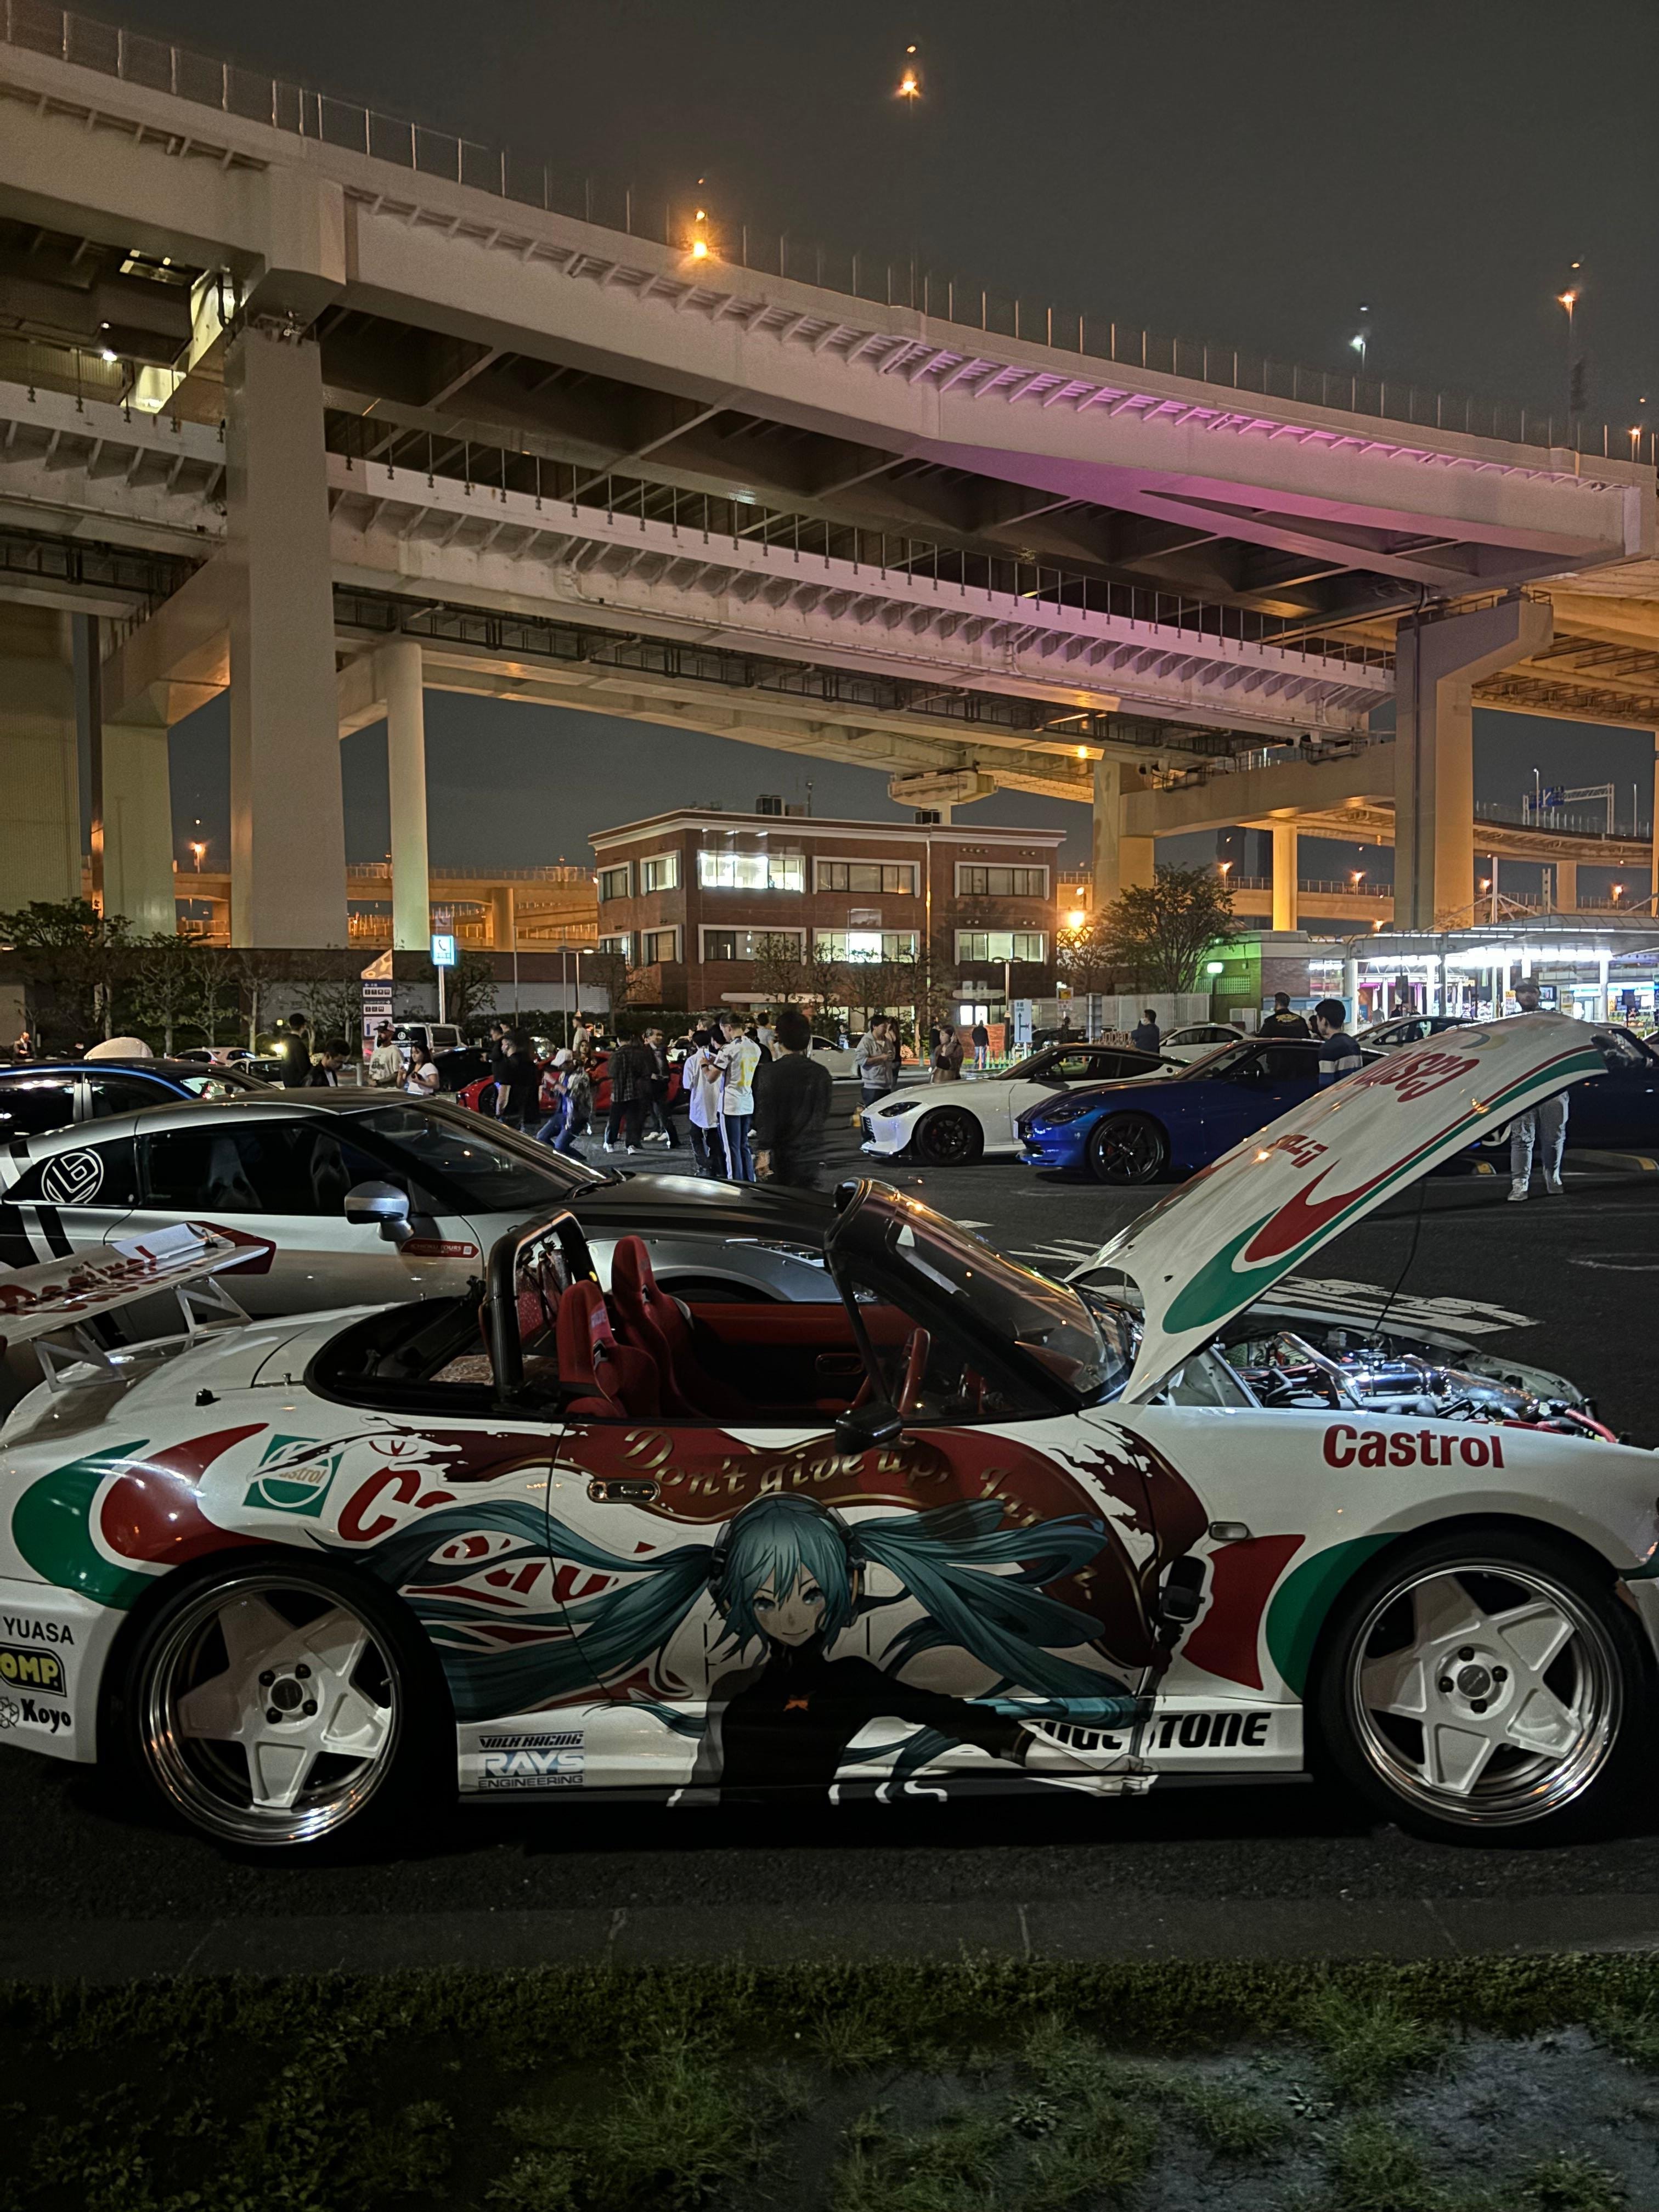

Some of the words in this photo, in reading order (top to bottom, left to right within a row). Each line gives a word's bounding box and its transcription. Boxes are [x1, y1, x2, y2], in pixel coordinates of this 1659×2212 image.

[1323, 1424, 1505, 1469] Castrol
[278, 1467, 328, 1484] strol
[616, 1427, 747, 1497] Don't
[756, 1452, 865, 1497] give
[3, 1616, 75, 1645] YUASA
[21, 1698, 71, 1734] Koyo
[479, 1736, 522, 1748] VOLK
[521, 1734, 584, 1747] RACING
[485, 1750, 585, 1777] RAYS
[478, 1775, 583, 1788] ENGINEERING
